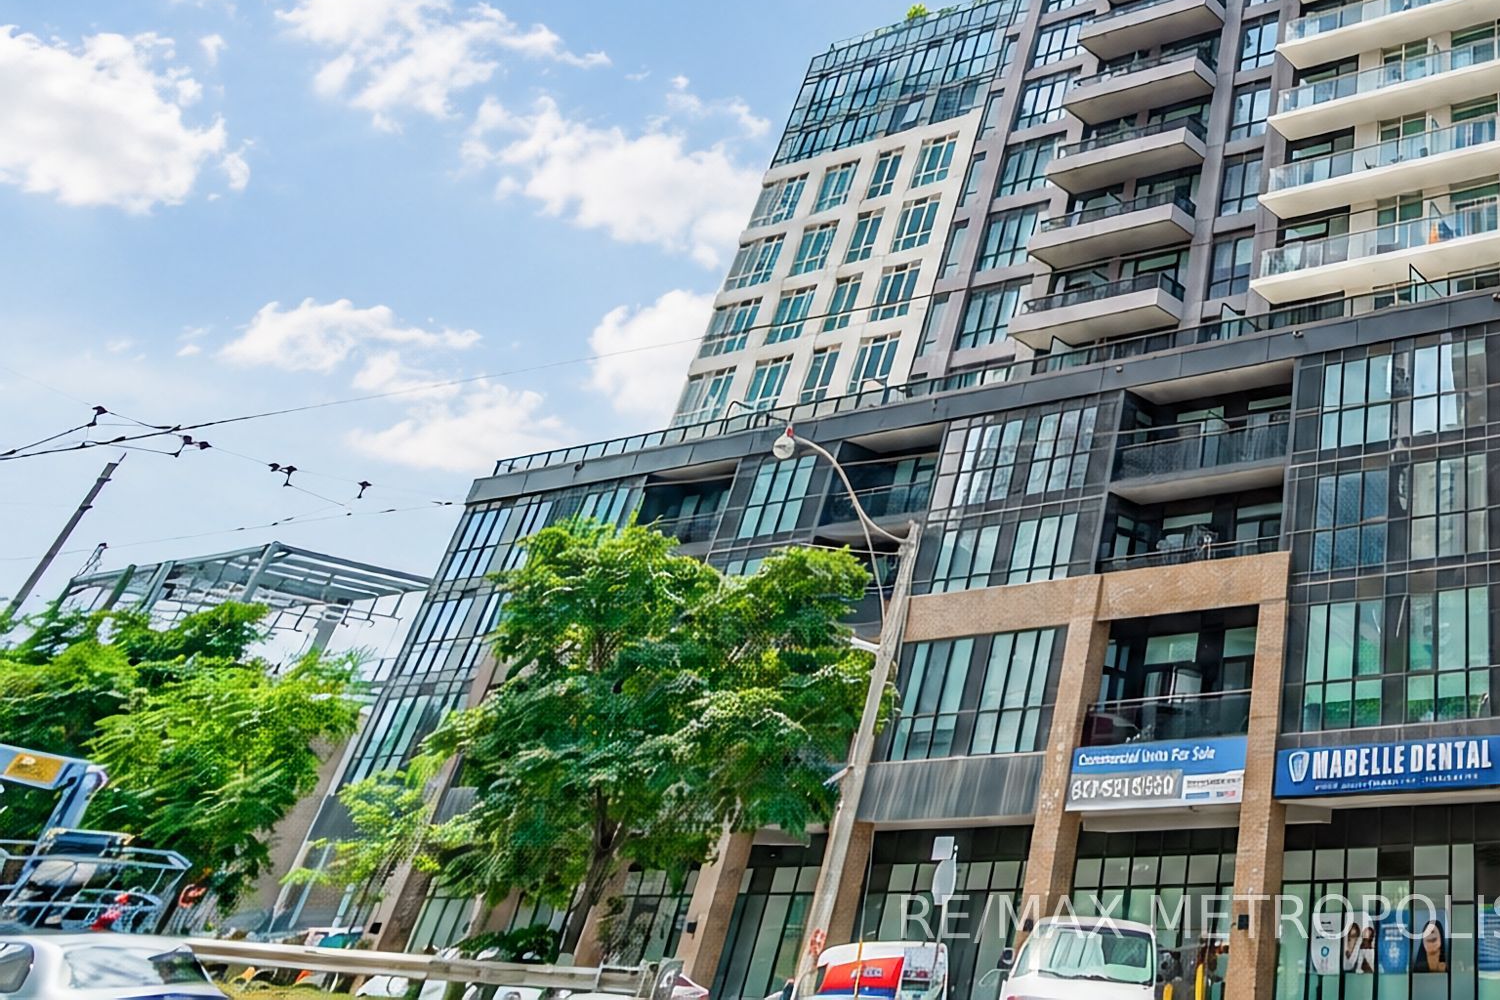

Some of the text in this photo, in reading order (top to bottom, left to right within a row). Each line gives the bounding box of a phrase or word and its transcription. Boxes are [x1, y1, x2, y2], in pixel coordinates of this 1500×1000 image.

[1171, 747, 1190, 761] For
[1192, 745, 1216, 760] Sale
[1312, 739, 1492, 780] MABELLE DENTAL
